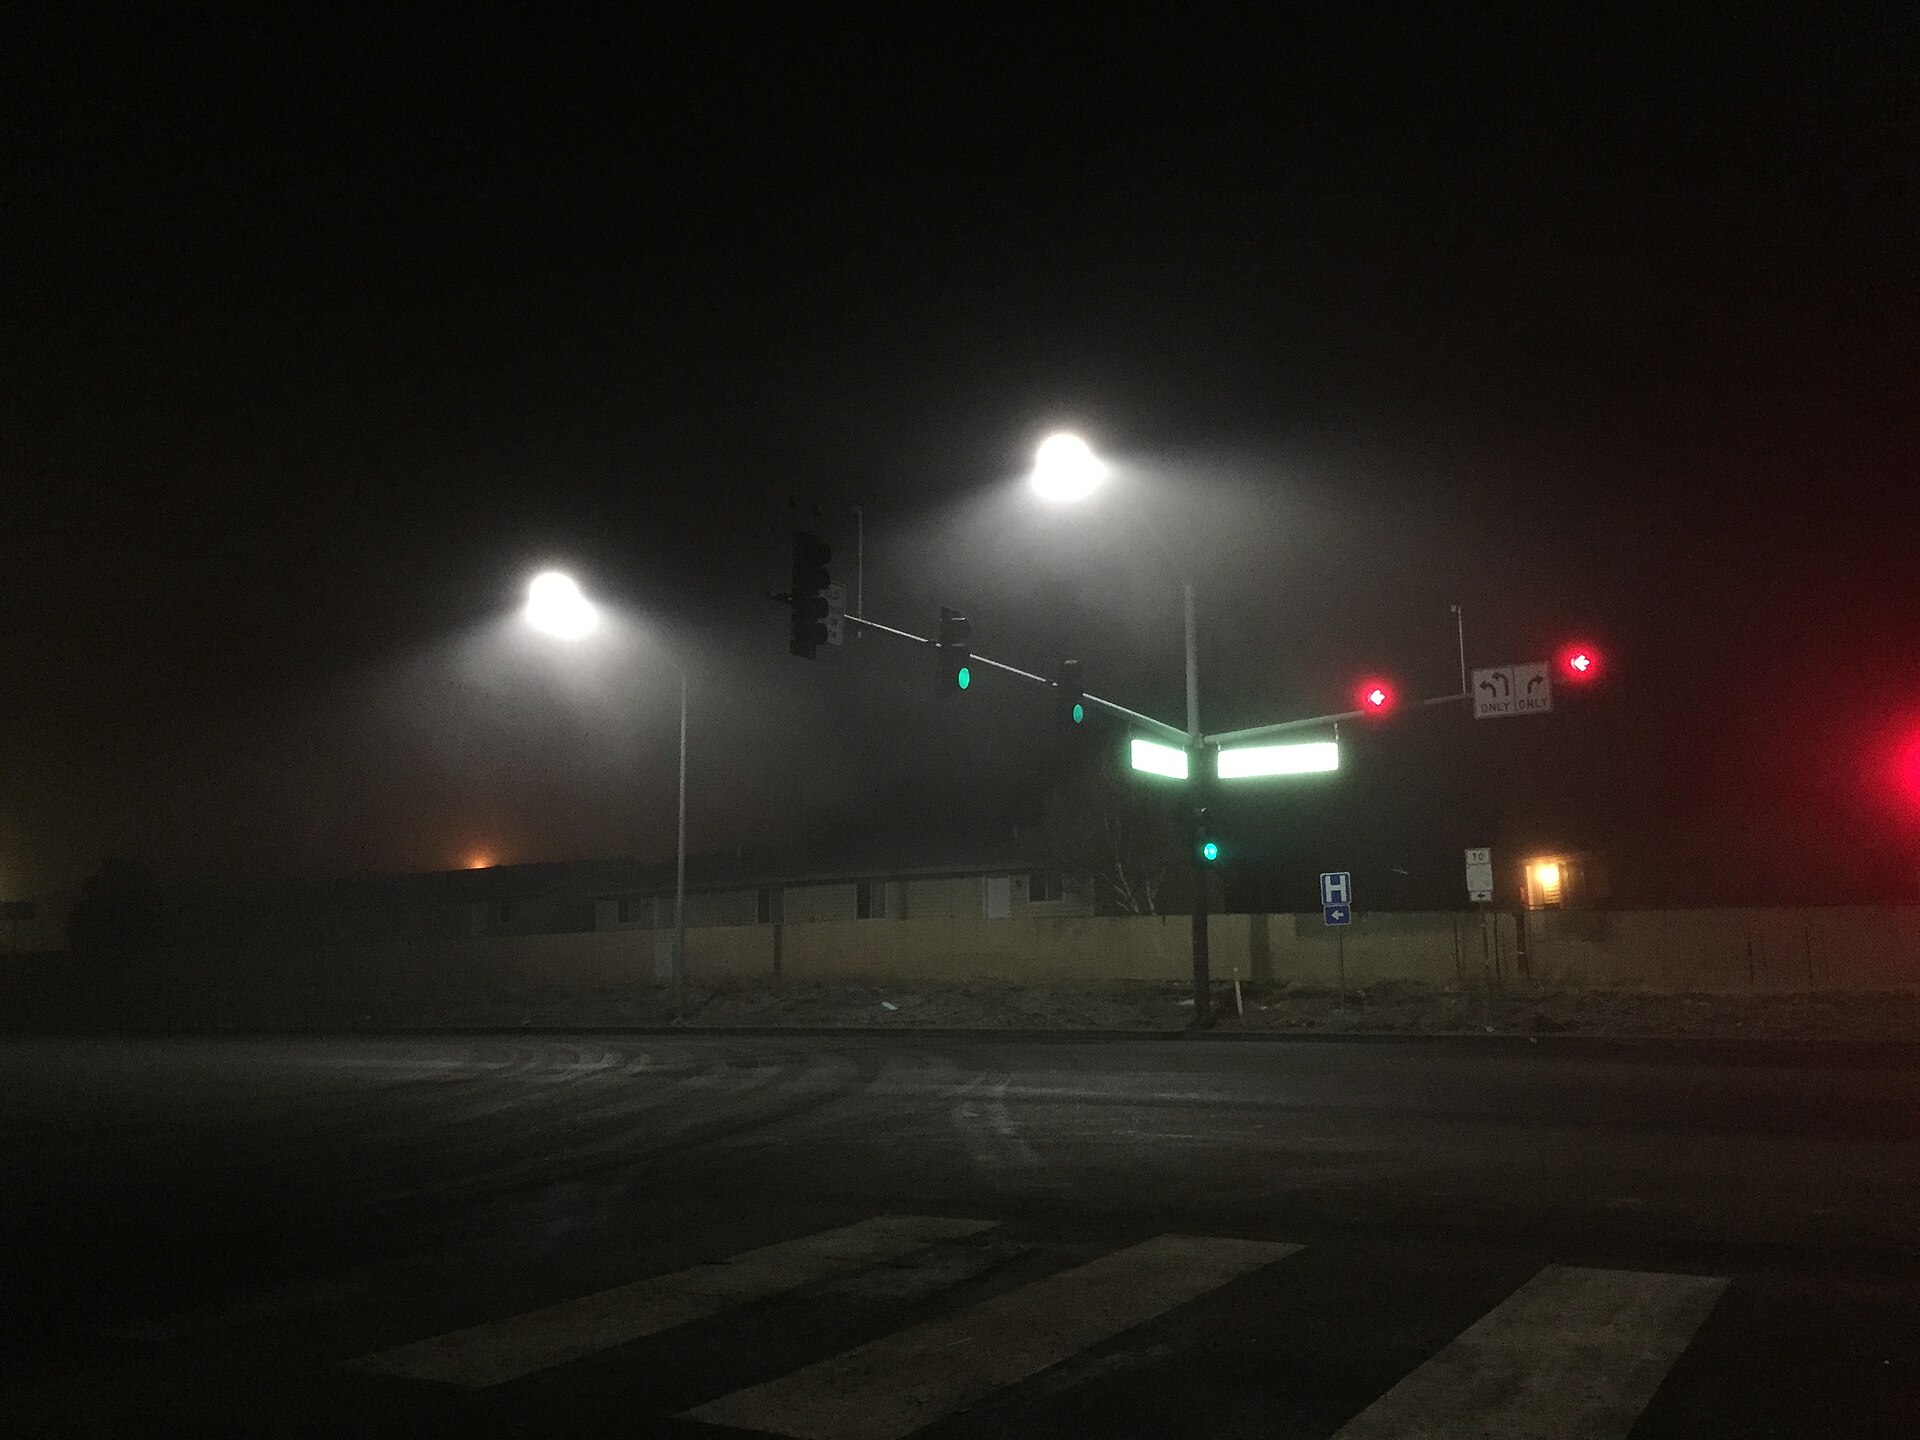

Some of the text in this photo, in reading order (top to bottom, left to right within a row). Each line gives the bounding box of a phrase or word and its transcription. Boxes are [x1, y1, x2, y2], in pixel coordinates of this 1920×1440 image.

[1480, 702, 1510, 713] ONLY
[1518, 698, 1548, 710] ONLY
[1325, 875, 1347, 902] H
